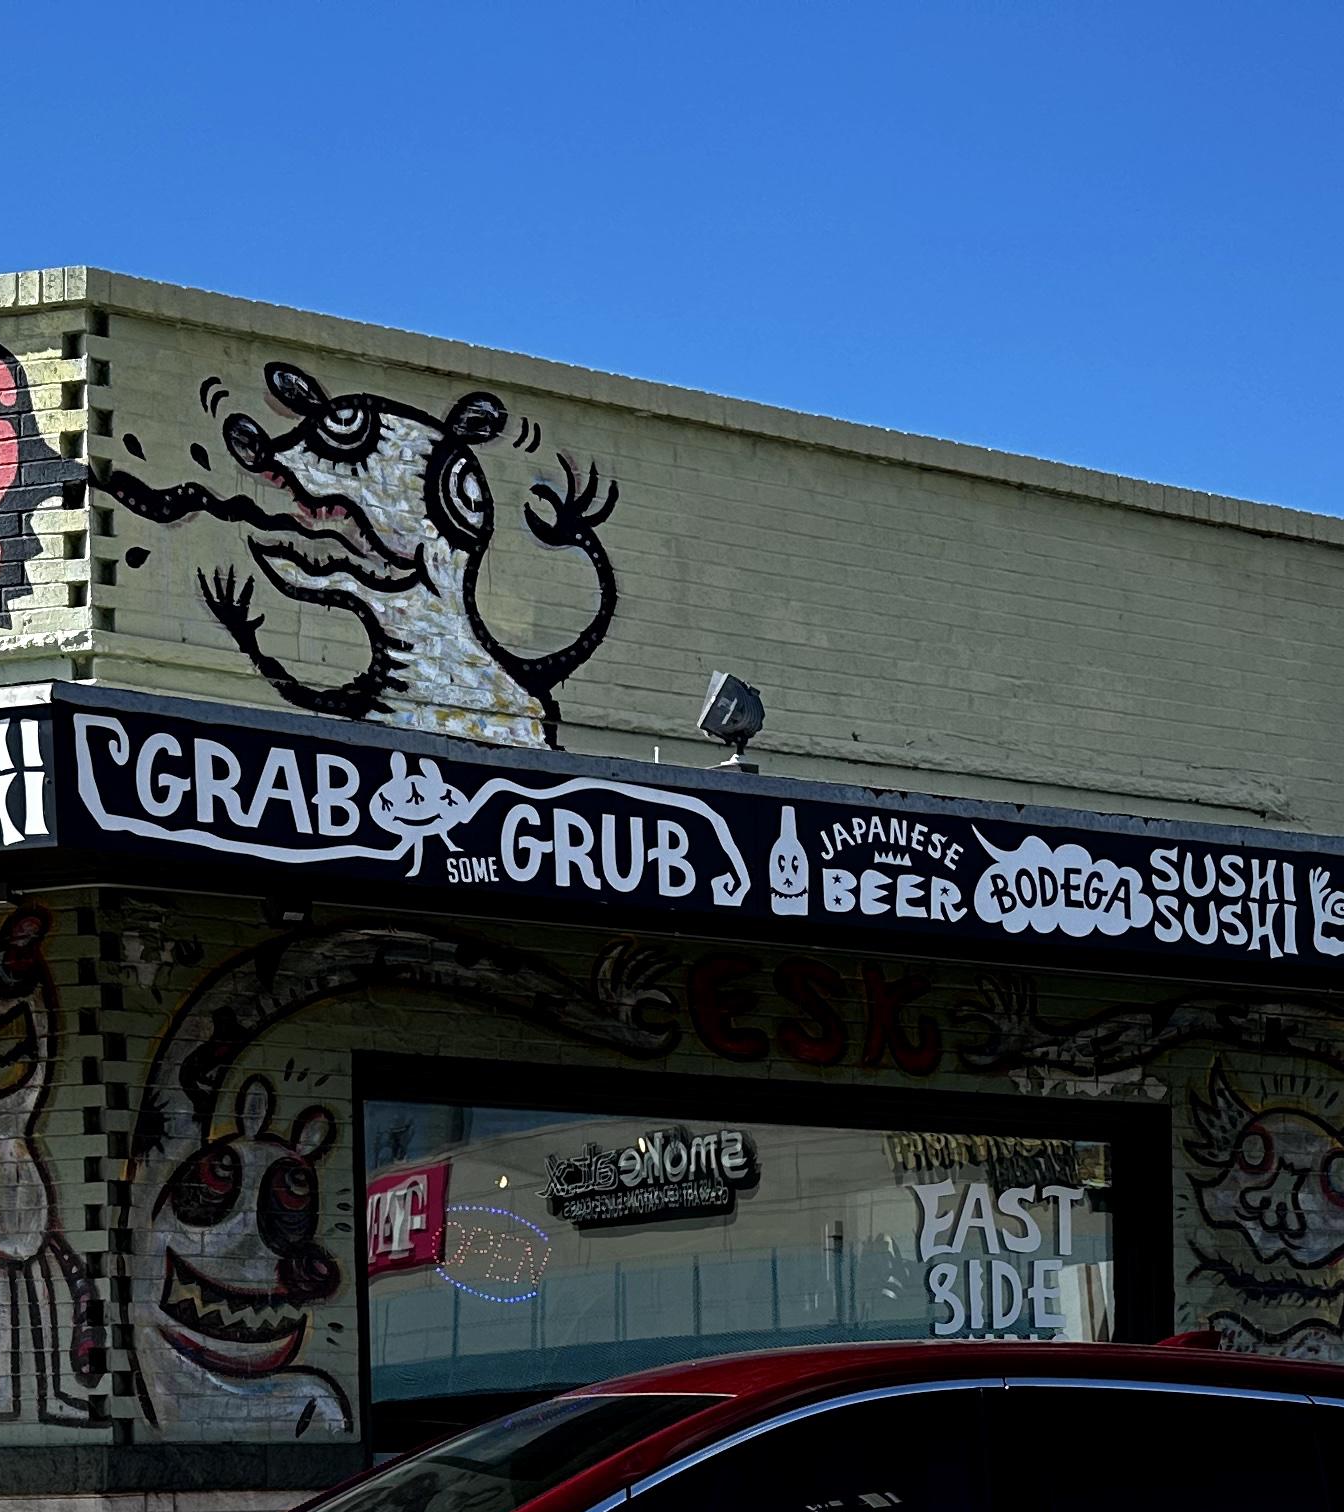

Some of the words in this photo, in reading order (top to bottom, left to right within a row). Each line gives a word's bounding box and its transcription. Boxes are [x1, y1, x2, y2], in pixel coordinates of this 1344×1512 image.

[136, 732, 361, 837] GRAB
[447, 856, 499, 884] SOME
[501, 803, 696, 898] GRUB
[820, 815, 964, 871] JAPANESE
[822, 867, 968, 922] BEER
[989, 866, 1134, 921] BODEGA
[1150, 847, 1297, 902] SUSHI
[1153, 895, 1299, 959] SUSHI
[911, 1178, 1085, 1263] EAST
[432, 1222, 551, 1286] OPEN
[928, 1259, 1067, 1336] SIDE
